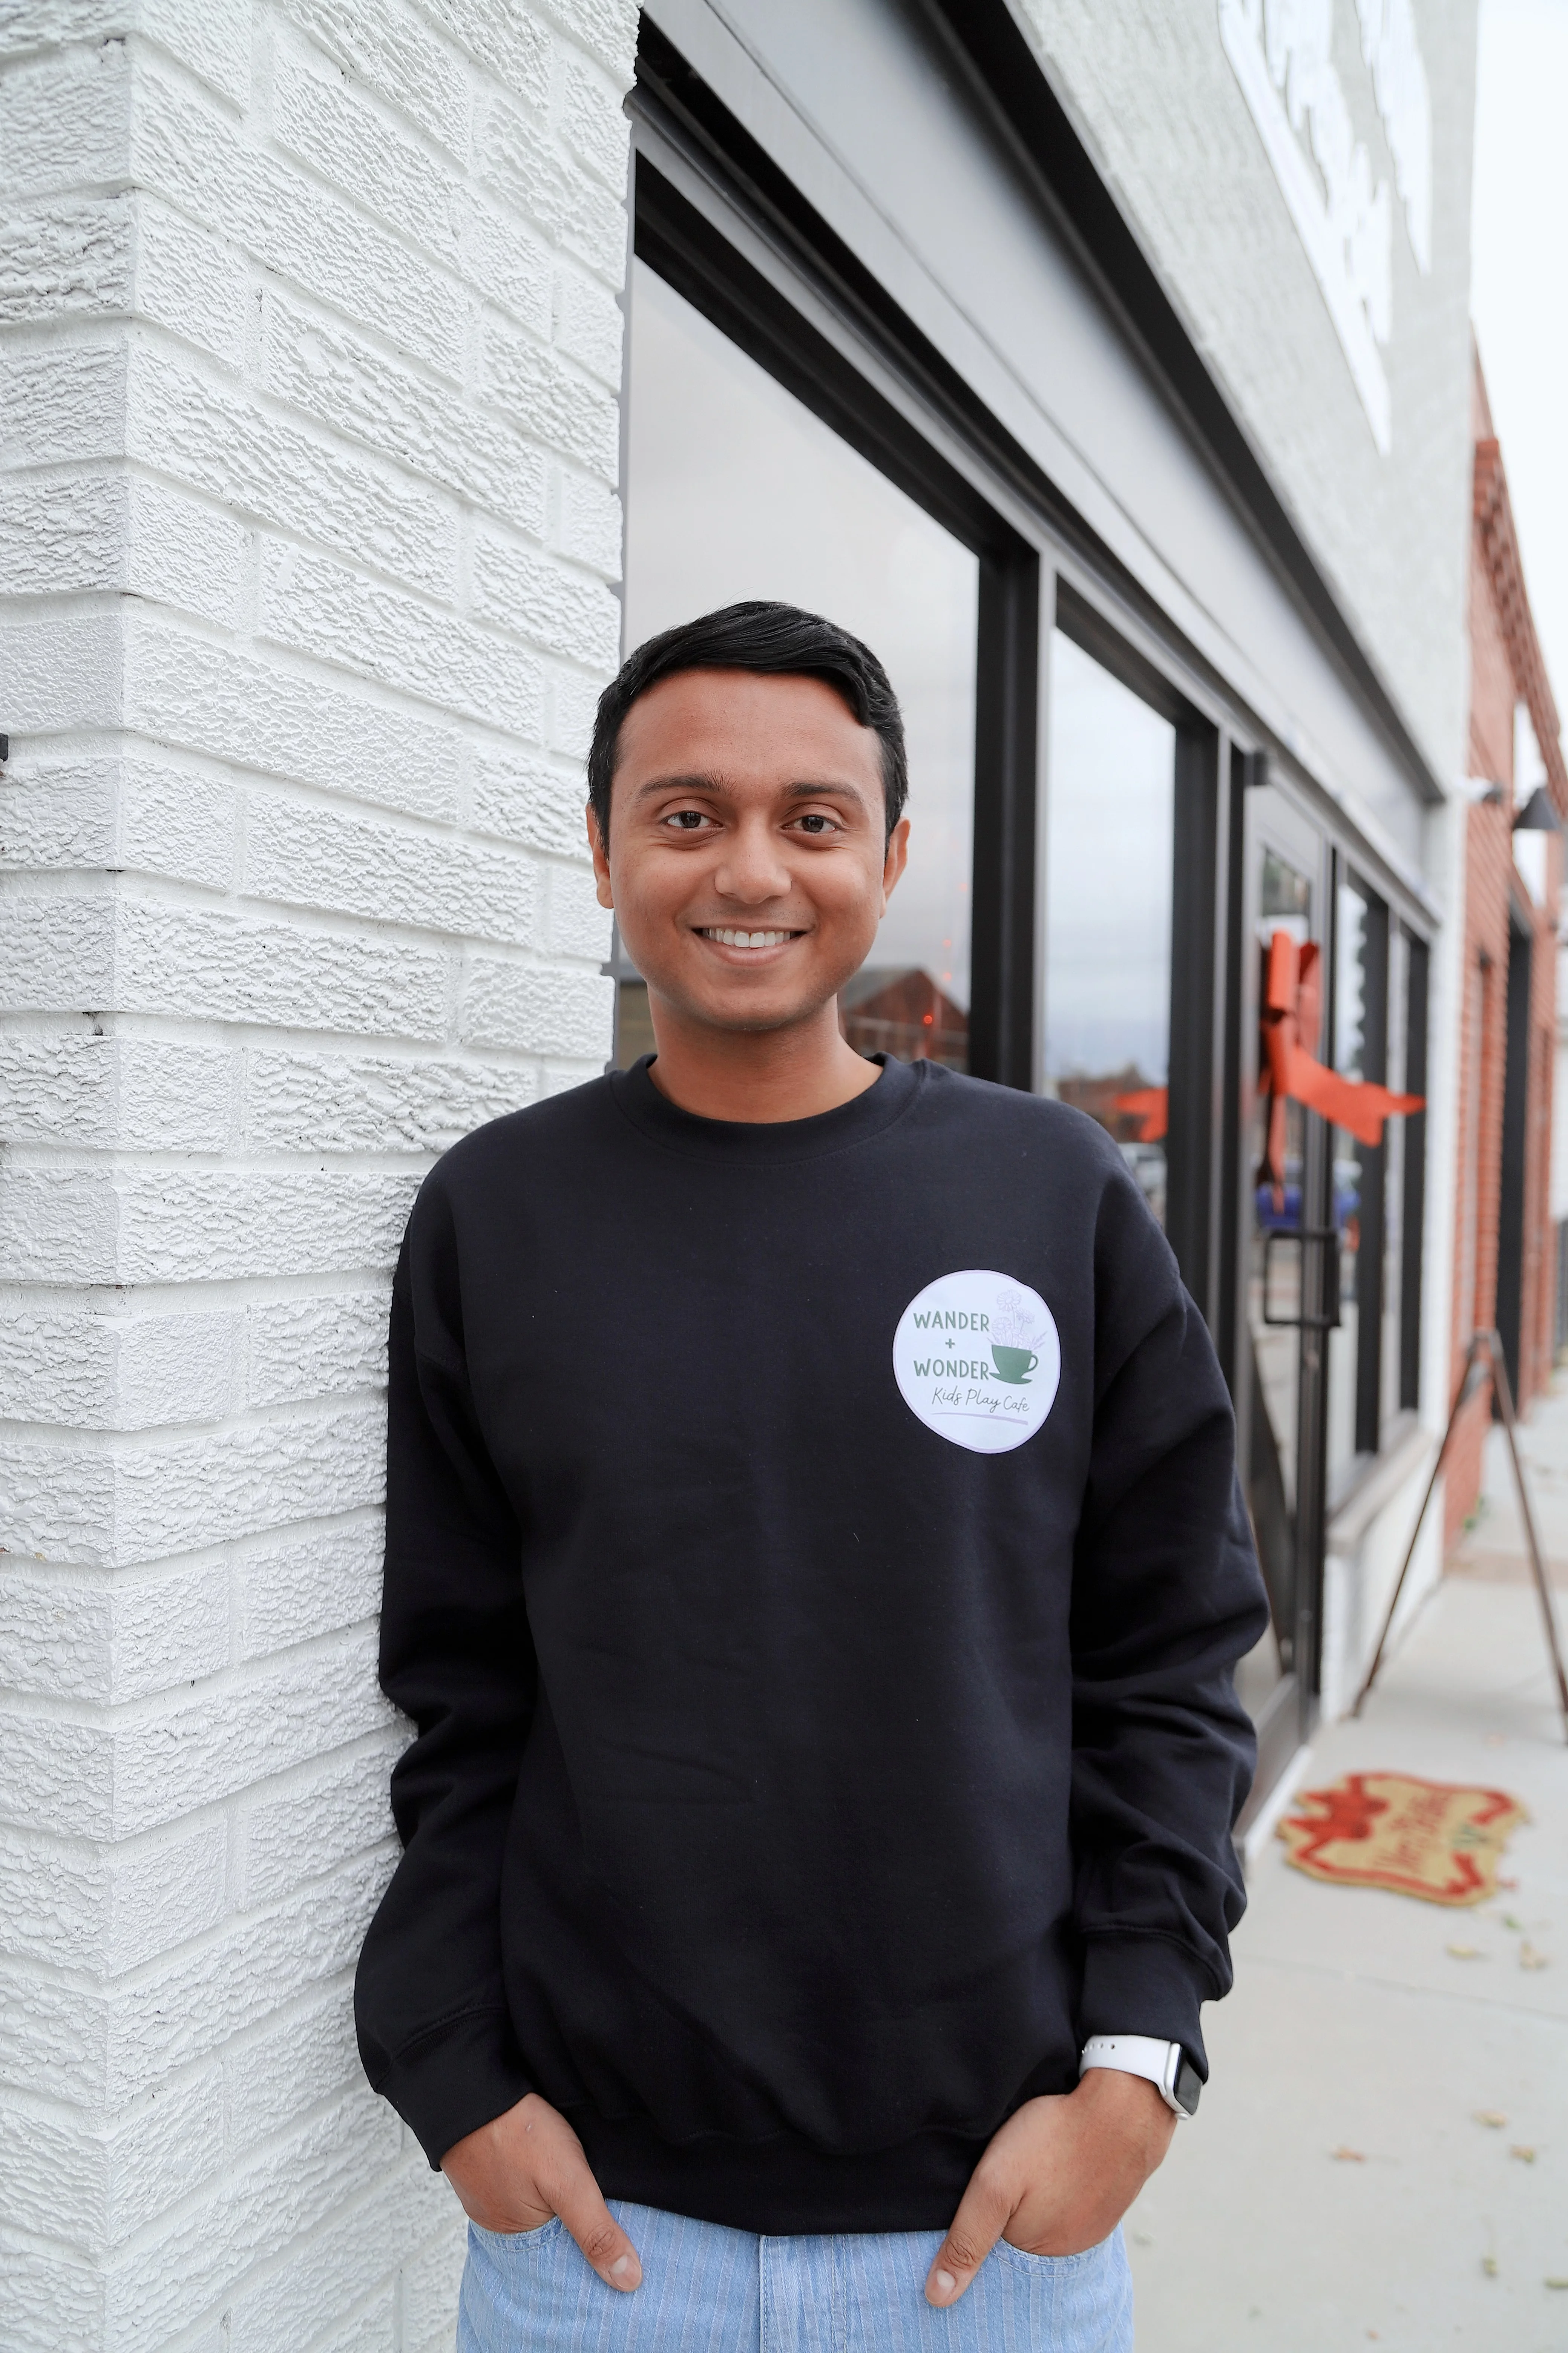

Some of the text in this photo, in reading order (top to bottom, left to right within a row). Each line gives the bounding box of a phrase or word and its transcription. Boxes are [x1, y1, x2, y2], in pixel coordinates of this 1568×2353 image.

[913, 1310, 990, 1332] WANDER
[945, 1338, 956, 1349] +
[913, 1358, 989, 1381] WONDER
[932, 1385, 1030, 1414] Kids Play Cafe
